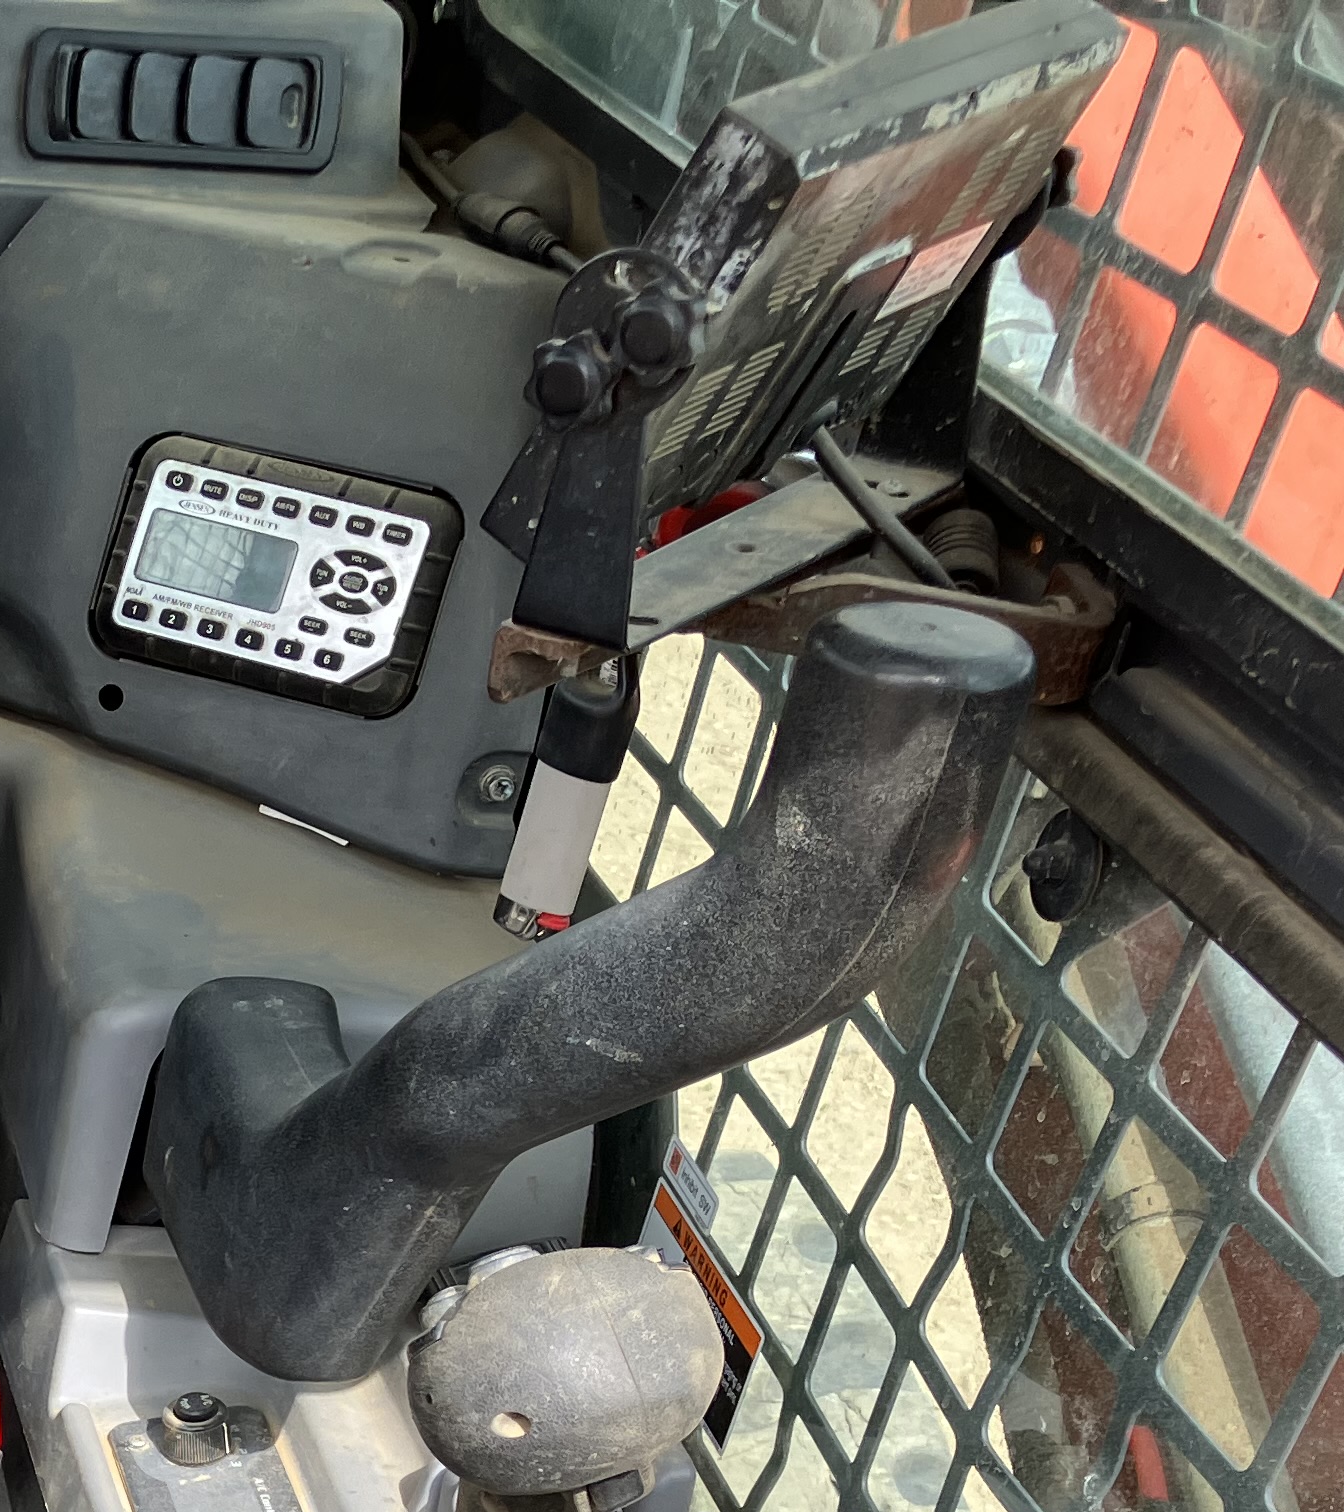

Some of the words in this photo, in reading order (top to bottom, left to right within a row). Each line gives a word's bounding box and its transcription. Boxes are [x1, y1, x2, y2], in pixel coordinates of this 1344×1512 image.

[202, 483, 222, 494] MUTE
[238, 492, 258, 503] DISP
[183, 501, 210, 513] JENSEN
[218, 509, 251, 523] HEAVY
[252, 518, 280, 530] DUTY
[313, 511, 330, 521] AUX
[150, 593, 193, 609] AM/FM/WB
[192, 603, 234, 619] RECEIVER
[242, 633, 252, 644] 4
[681, 1234, 728, 1303] WARNING
[254, 1476, 268, 1492] A/C
